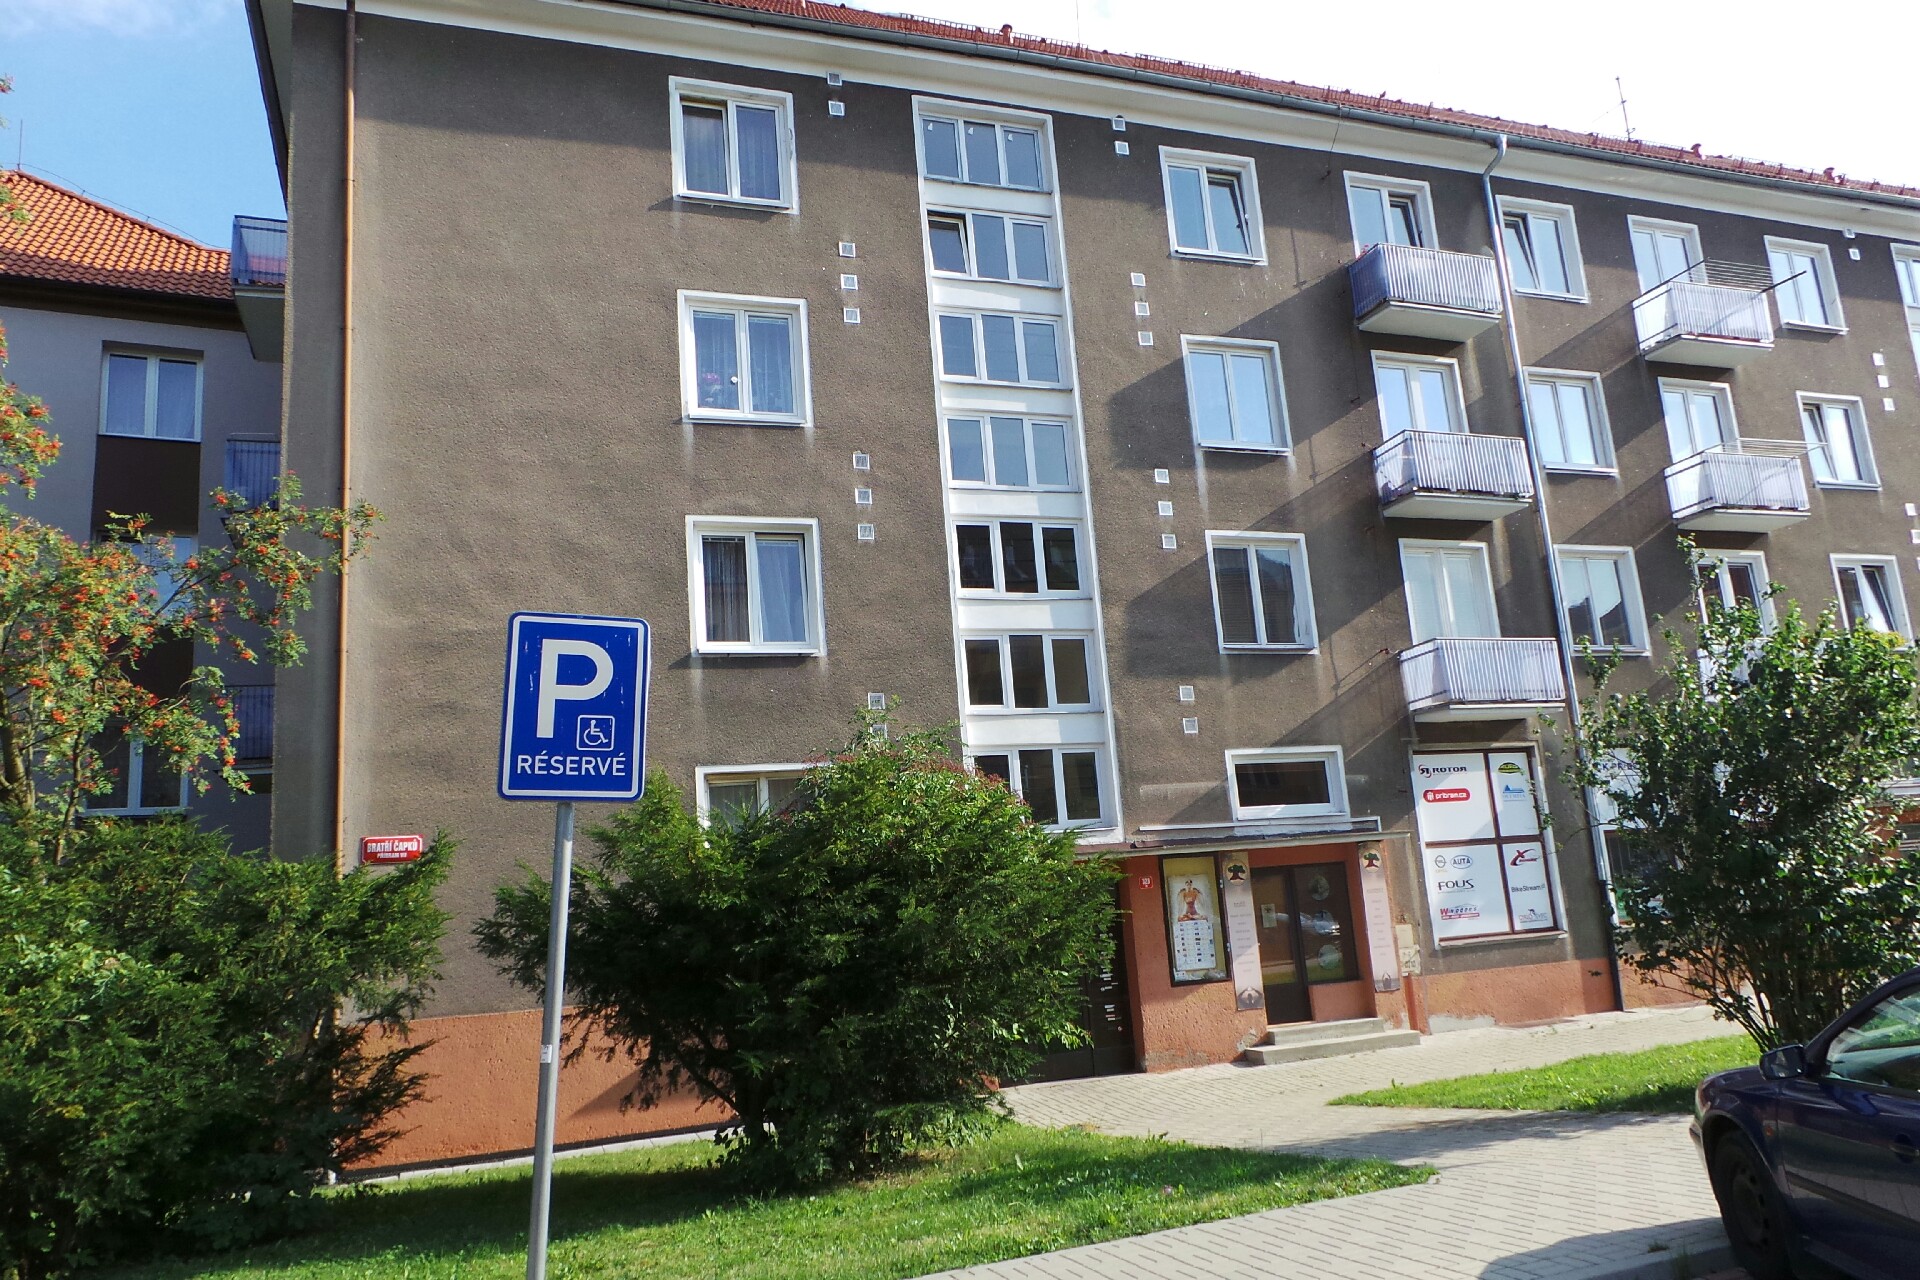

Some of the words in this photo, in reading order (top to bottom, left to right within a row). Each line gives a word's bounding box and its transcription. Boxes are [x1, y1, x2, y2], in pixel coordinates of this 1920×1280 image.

[536, 638, 614, 739] P
[516, 750, 626, 776] RÉSERVÉ
[1432, 766, 1467, 774] ROTOR
[367, 839, 392, 853] BRATŘÍ
[393, 838, 418, 852] ČAPKŮ
[1453, 857, 1471, 865] AUTA
[1437, 878, 1475, 890] FOUS
